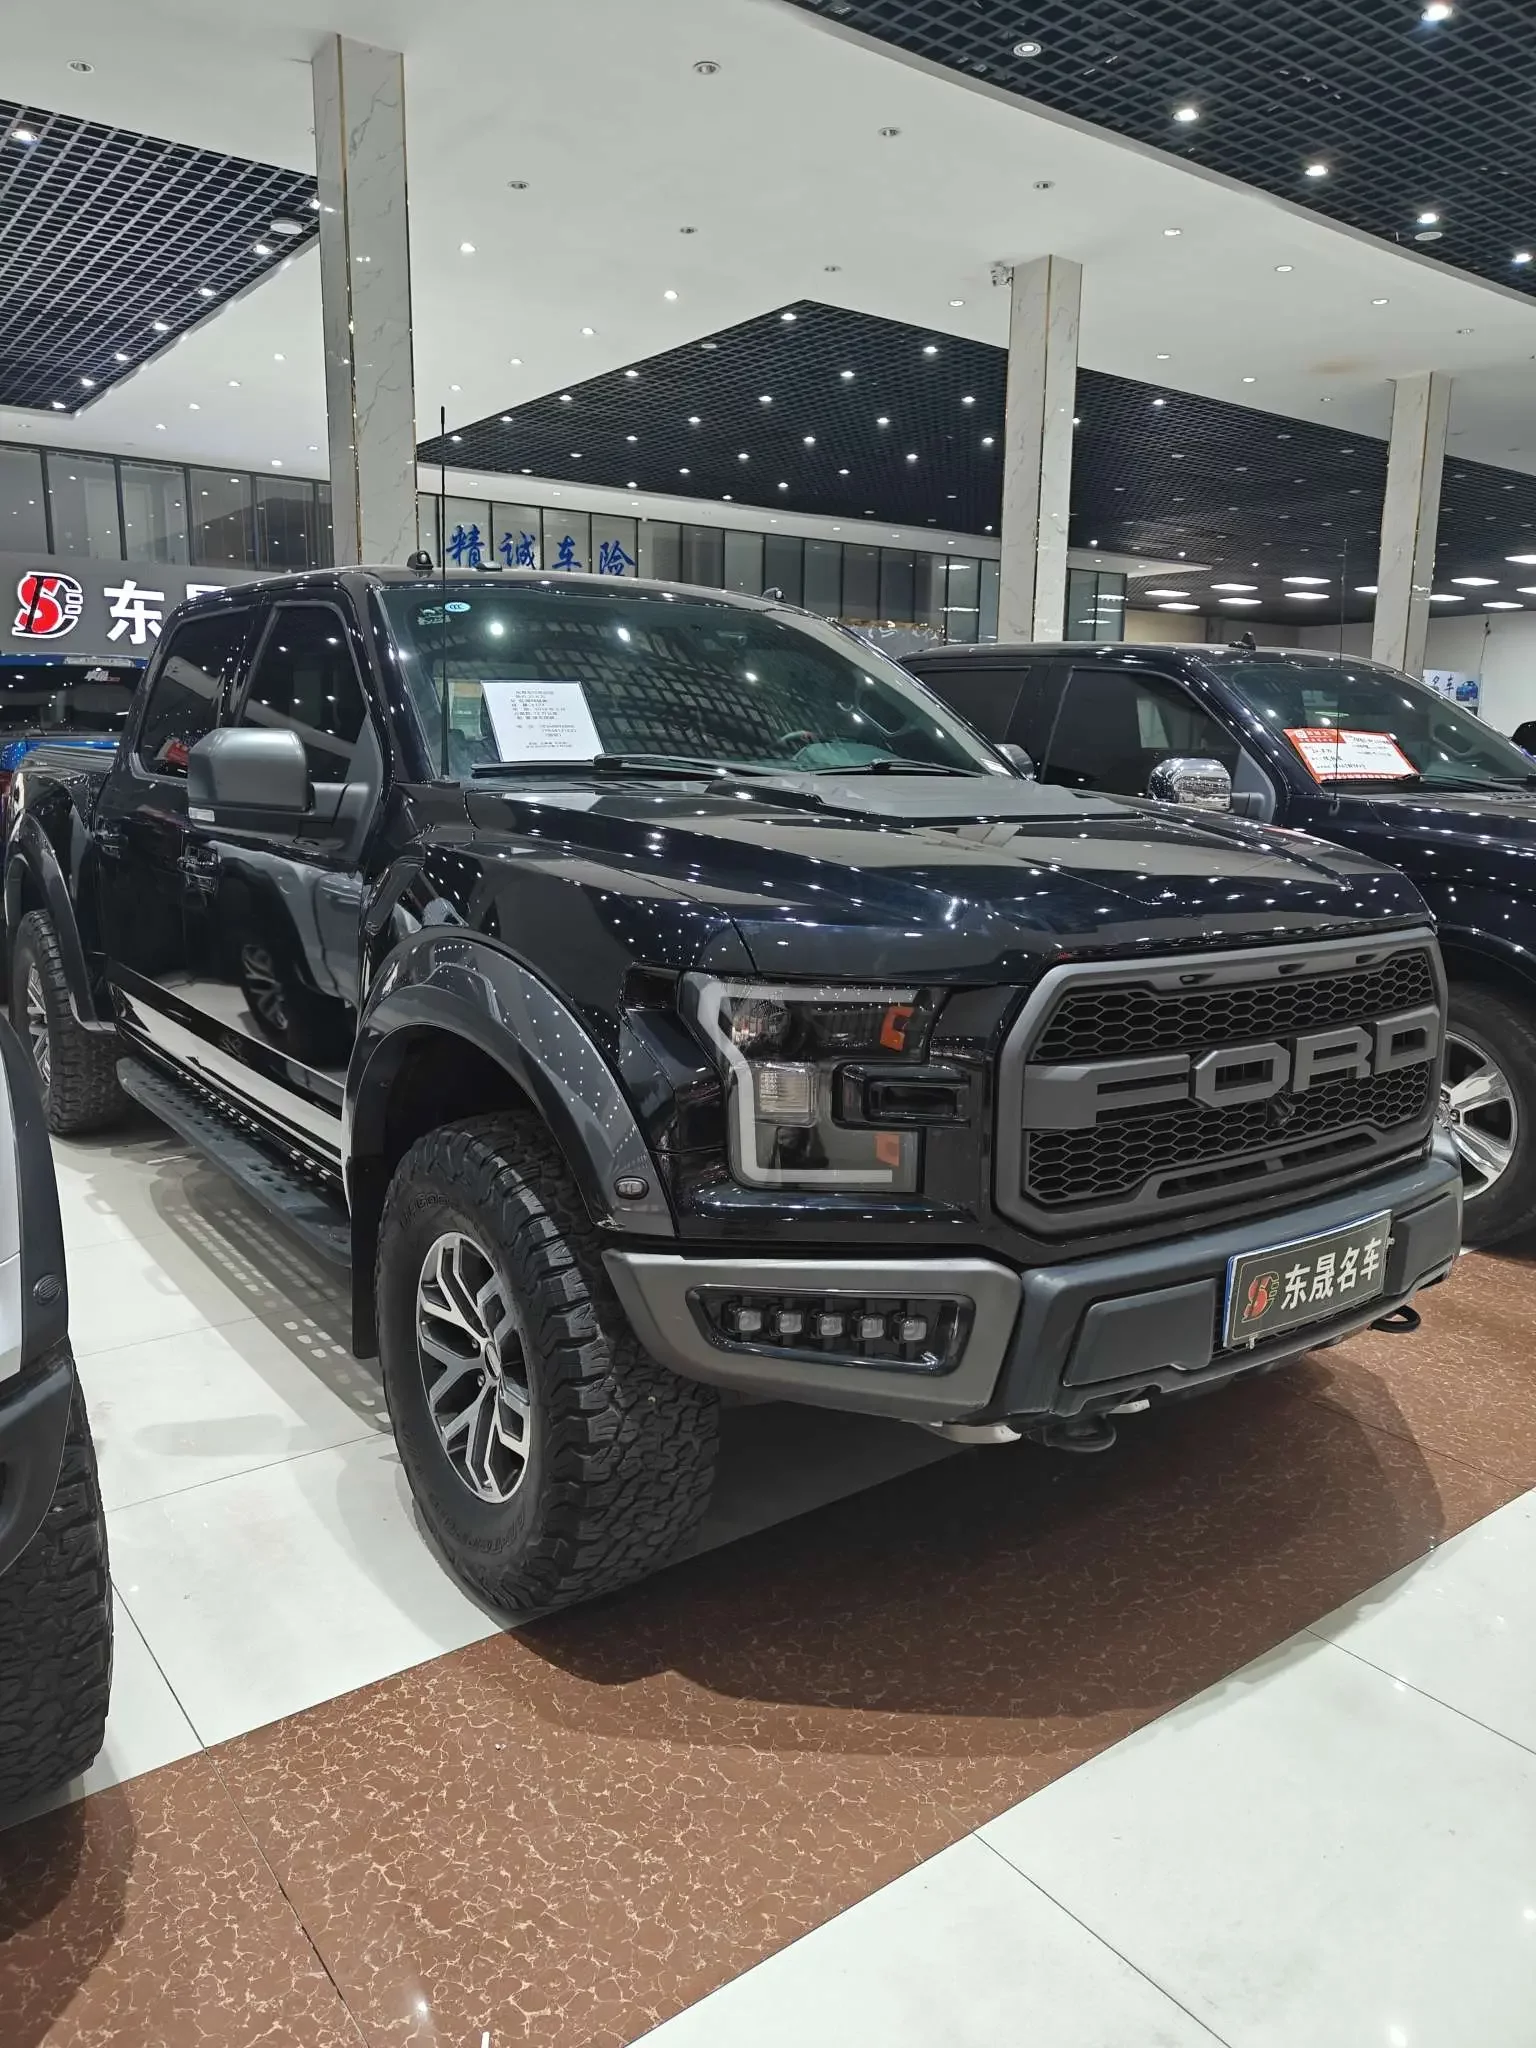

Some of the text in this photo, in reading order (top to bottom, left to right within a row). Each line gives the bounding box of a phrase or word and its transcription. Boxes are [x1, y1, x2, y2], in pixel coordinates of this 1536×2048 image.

[446, 524, 636, 577] 精诚车险
[1022, 1004, 1440, 1130] FORD
[1281, 1237, 1382, 1310] 东晟名车
